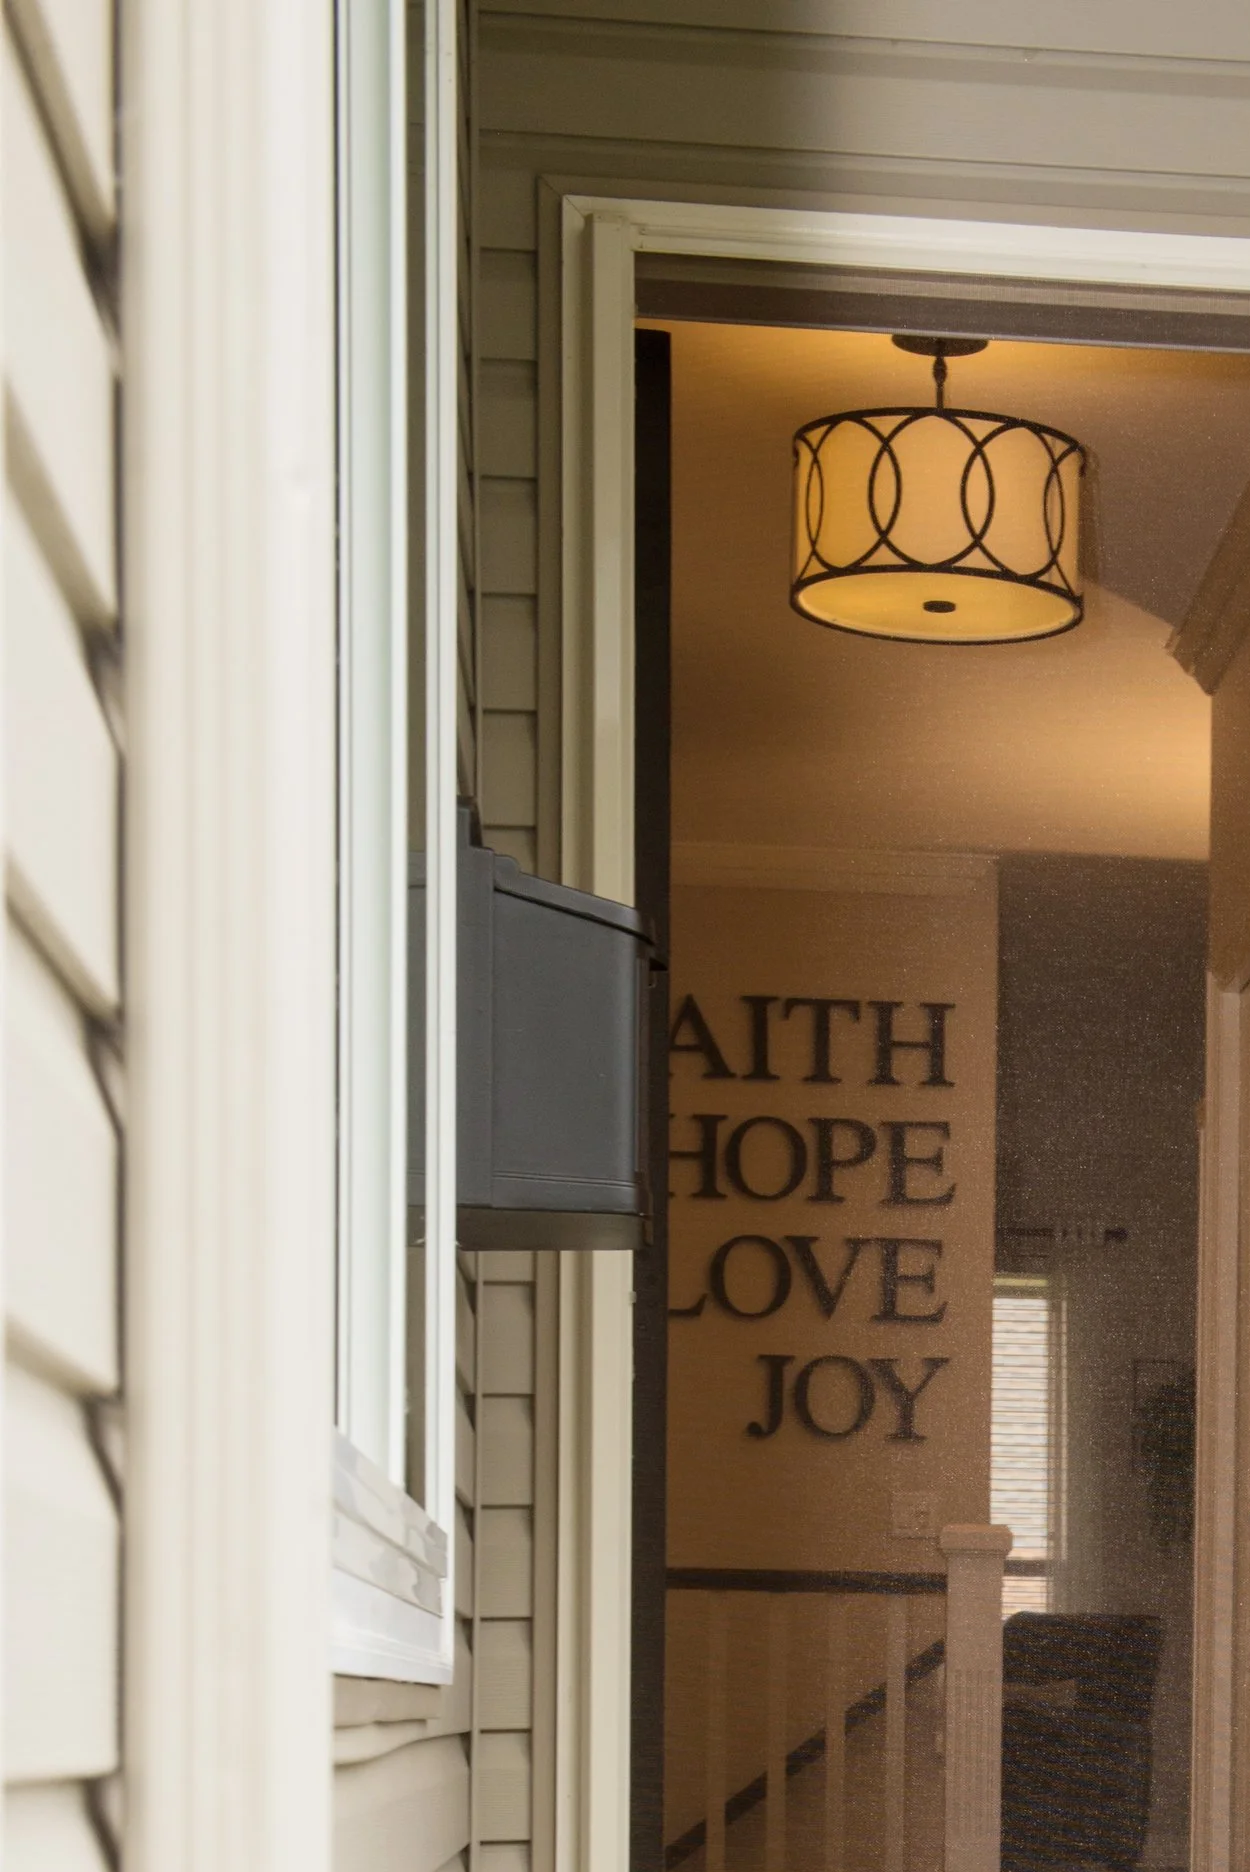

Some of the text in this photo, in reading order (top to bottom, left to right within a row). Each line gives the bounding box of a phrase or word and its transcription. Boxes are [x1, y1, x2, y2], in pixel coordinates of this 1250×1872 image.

[667, 994, 956, 1087] AITH
[667, 1113, 957, 1206] HOPE
[746, 1354, 950, 1443] JOY
